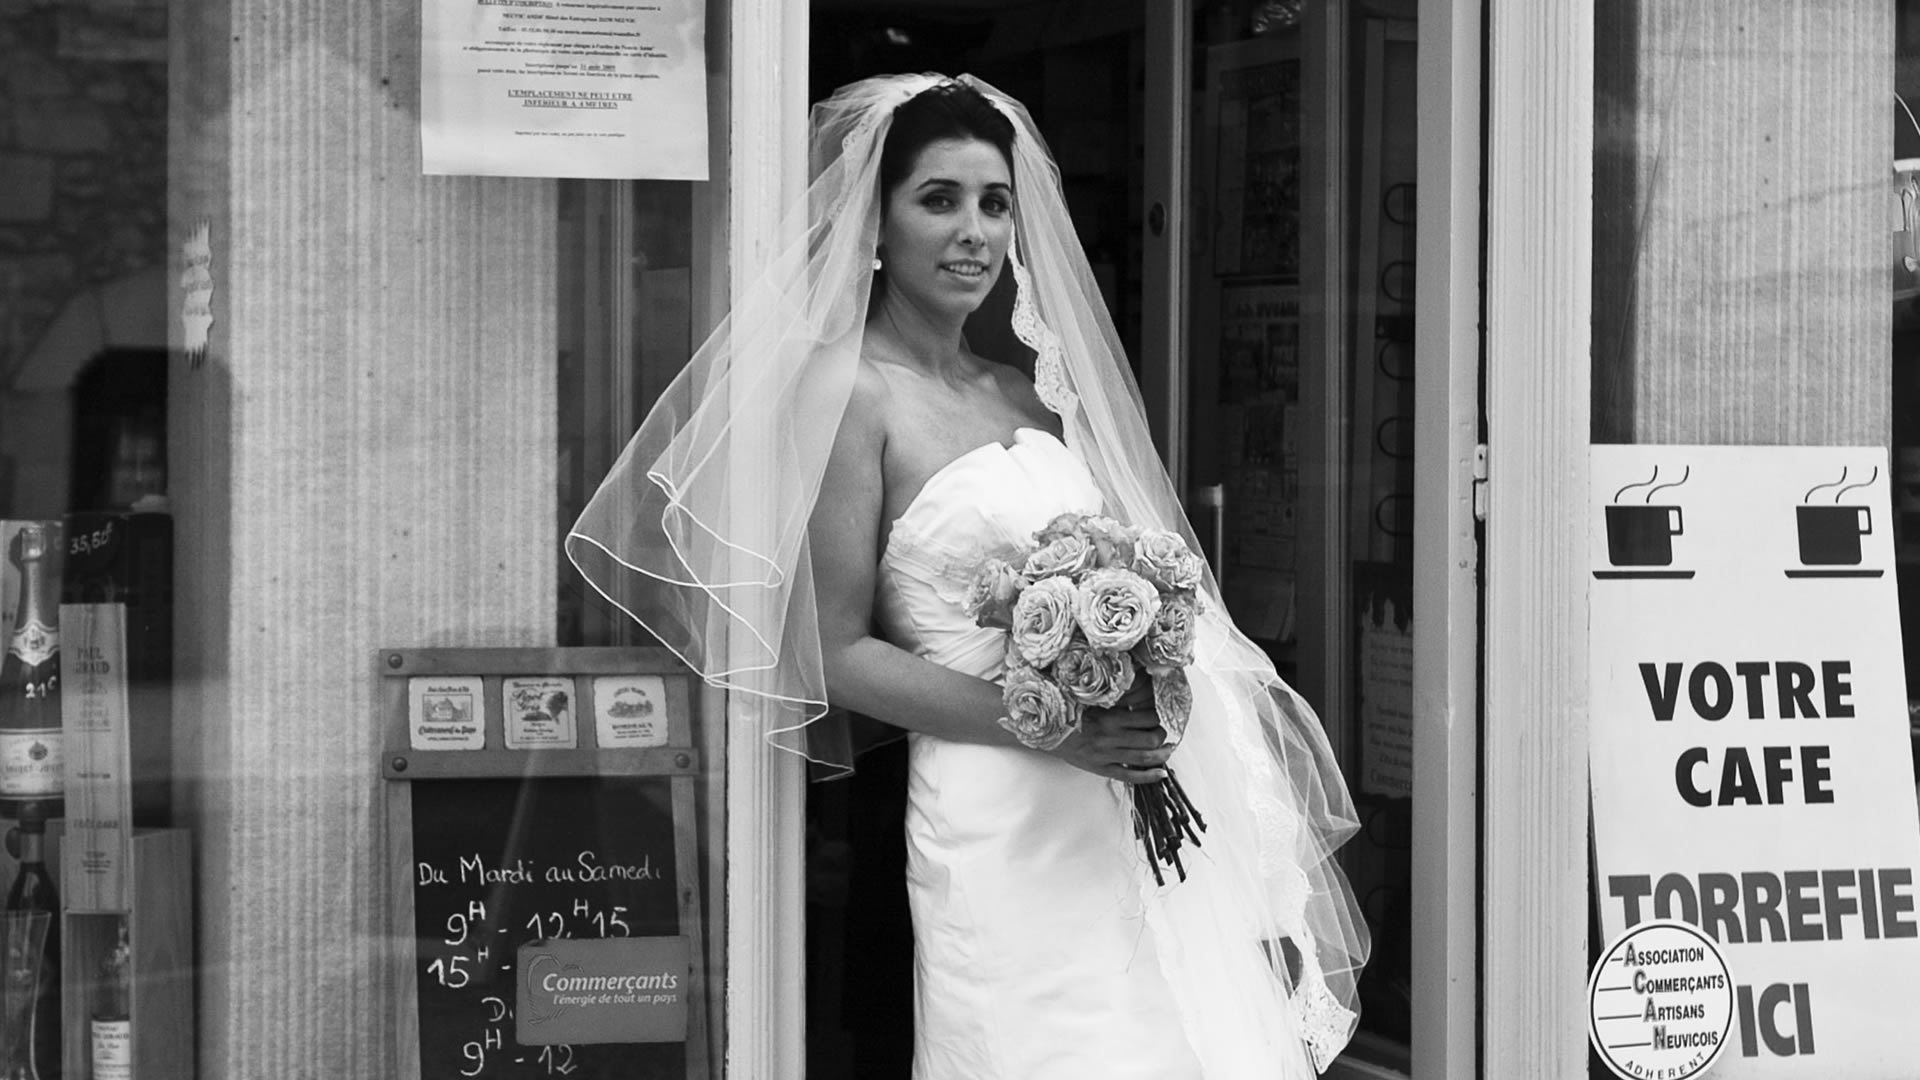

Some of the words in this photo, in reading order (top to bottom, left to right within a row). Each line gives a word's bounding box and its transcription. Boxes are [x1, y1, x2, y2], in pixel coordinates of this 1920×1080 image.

[508, 89, 576, 99] L'EMPLACEMENT
[578, 91, 589, 99] NE
[590, 92, 610, 100] PEUT
[611, 92, 633, 101] ETRE
[523, 99, 568, 108] INFERIEUR
[585, 101, 618, 109] METRES
[1638, 660, 1856, 721] VOTRE
[1675, 745, 1835, 808] CAFE
[419, 862, 449, 886] Du
[459, 853, 534, 886] Mardi
[545, 867, 575, 883] au
[577, 850, 661, 882] Samedi
[1608, 867, 1919, 944] TORREFIE
[1624, 942, 1704, 967] ASSOCIATION
[542, 972, 678, 994] Commerçants
[553, 994, 596, 1007] l'énergie
[598, 993, 612, 1004] de
[613, 993, 636, 1004] tout
[638, 995, 651, 1004] un
[652, 994, 677, 1006] pays
[1643, 997, 1705, 1022] ARTISANS
[1736, 983, 1815, 1058] ICI
[1653, 1025, 1719, 1050] NEUVICOIS
[1625, 1051, 1705, 1080] ADHERENT
